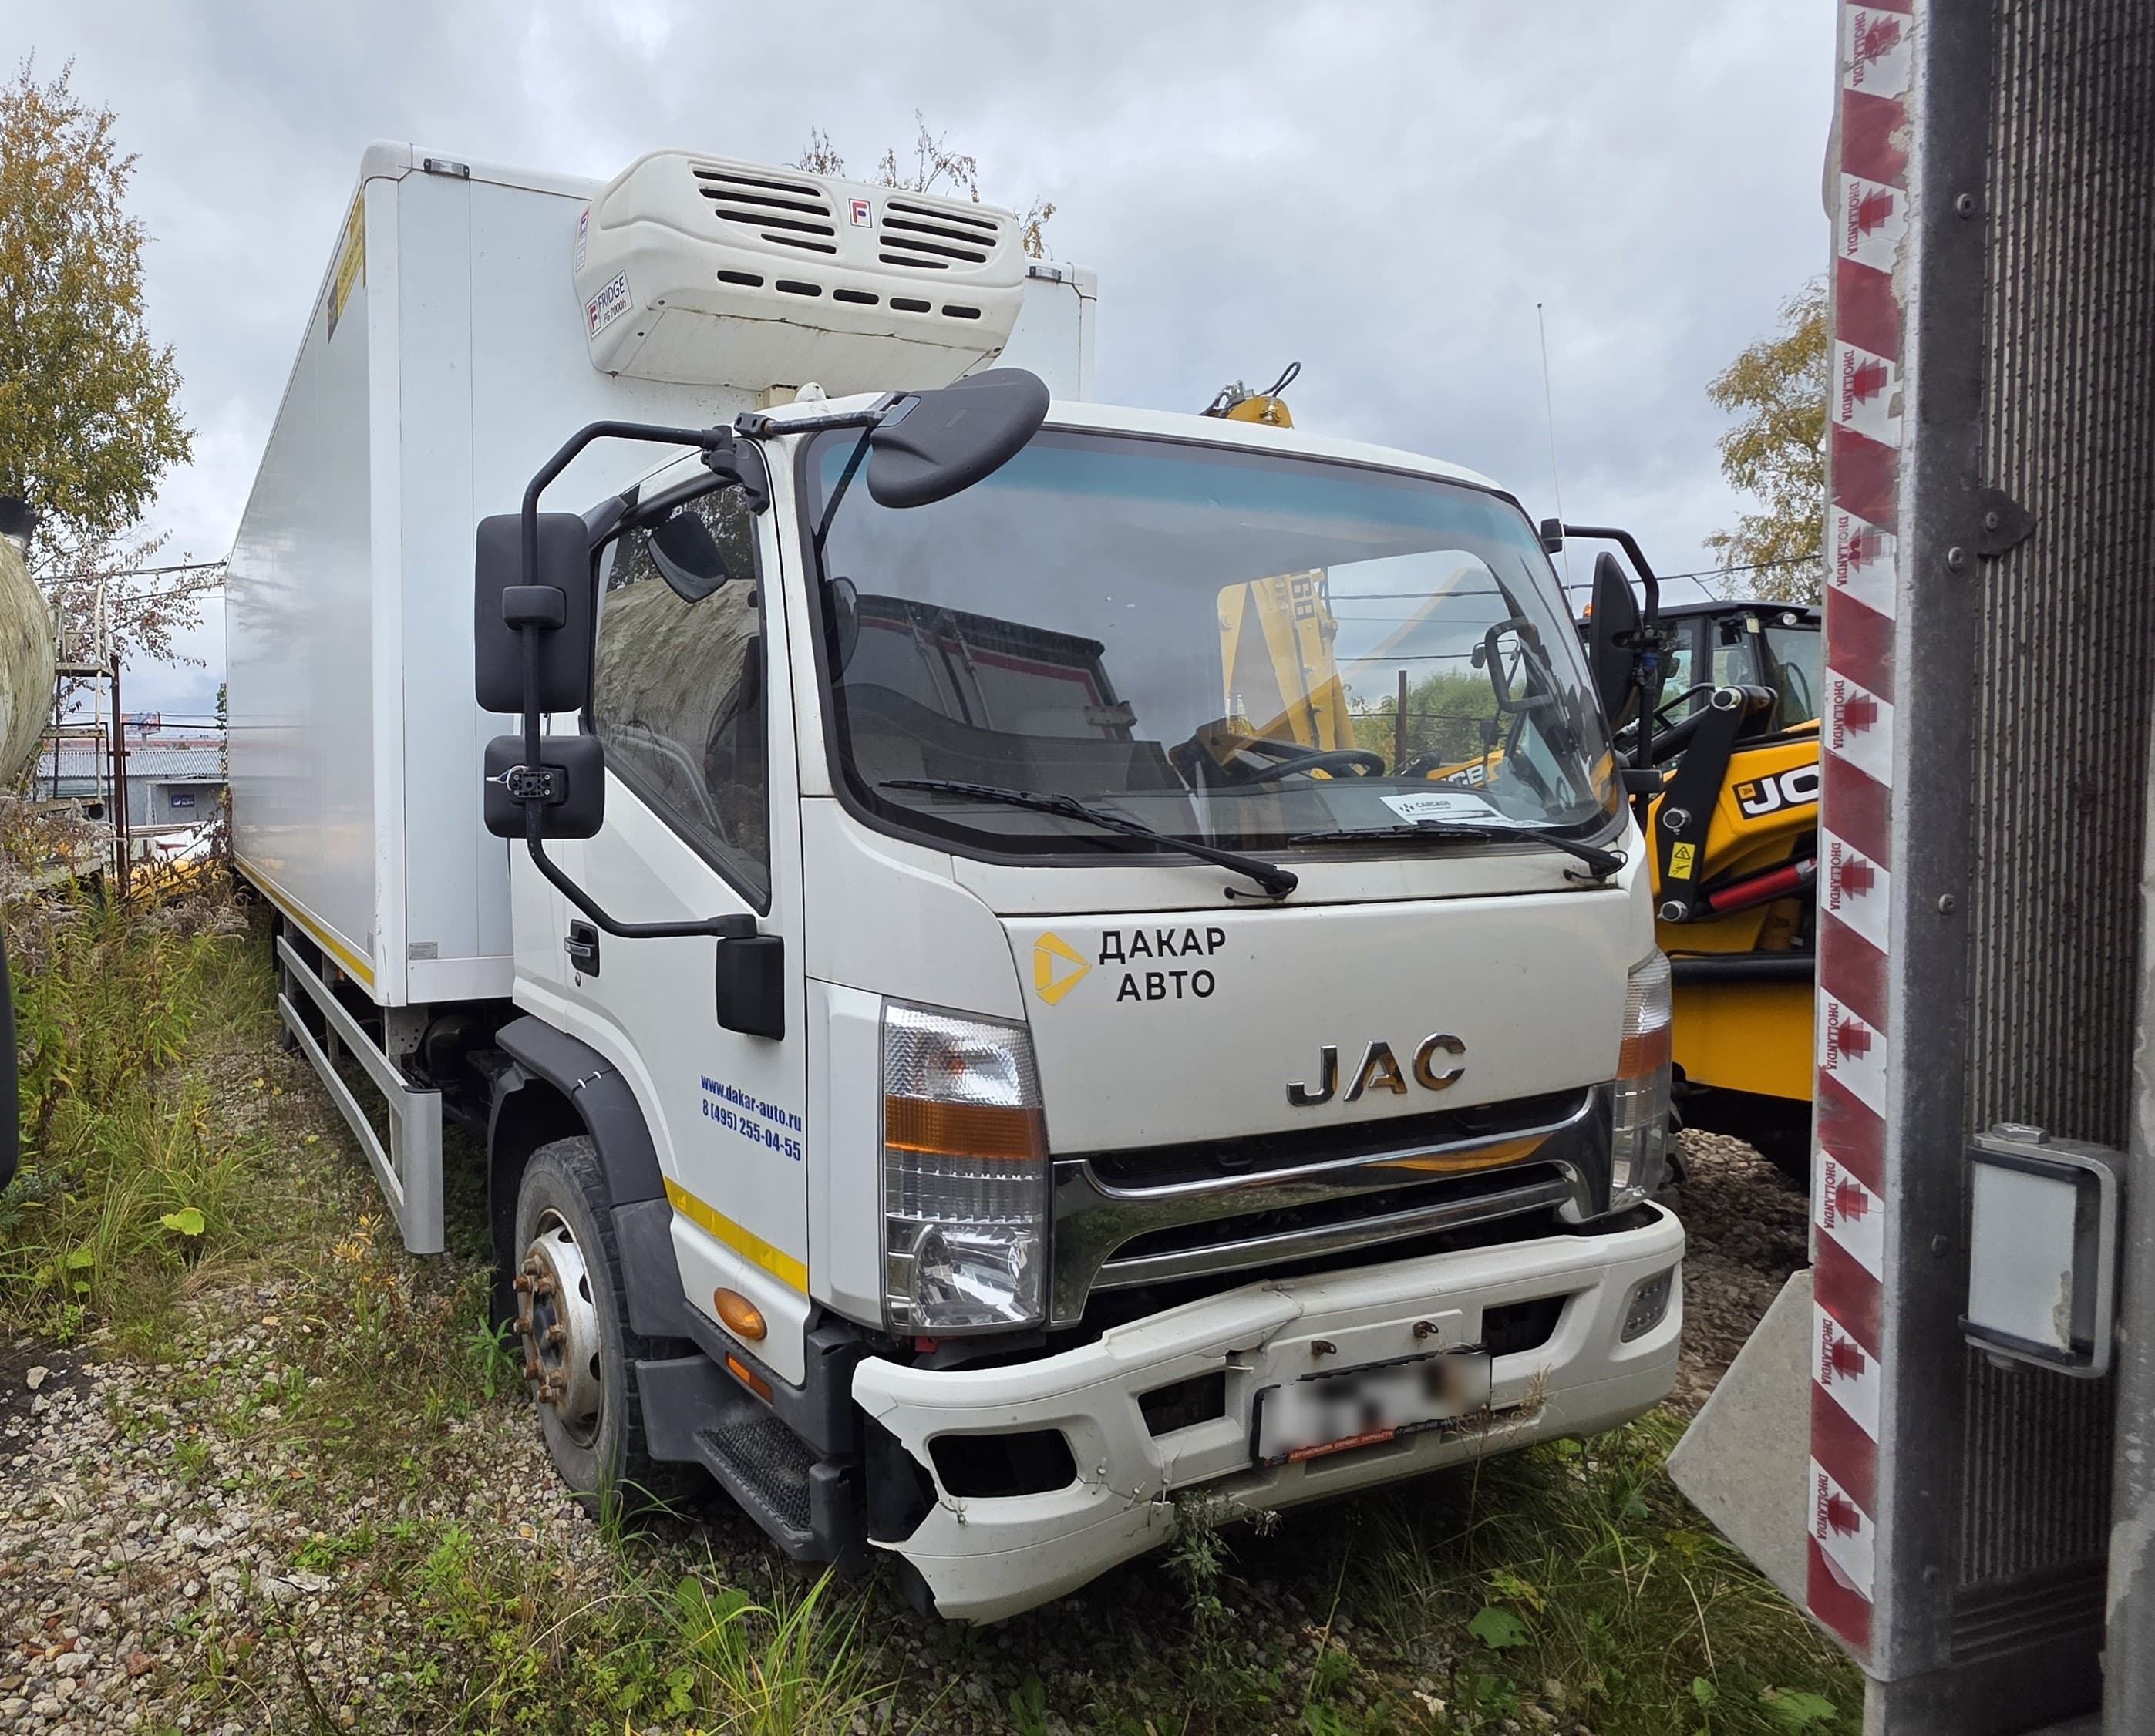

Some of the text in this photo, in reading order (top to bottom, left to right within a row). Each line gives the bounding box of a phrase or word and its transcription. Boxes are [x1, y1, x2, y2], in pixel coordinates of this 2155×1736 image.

[1847, 181, 1860, 256] DHOLLANDIA
[598, 275, 625, 311] FRIDGE
[1842, 349, 1855, 422] DHOLLANDIA
[1833, 679, 1845, 750] DHOLLANDIA
[1743, 764, 1819, 814] JC
[1830, 842, 1842, 911] DHOLLANDIA
[1099, 927, 1227, 965] ДАКАР
[1116, 969, 1216, 1002] АВТО
[1286, 1031, 1466, 1107] JAC
[1826, 1002, 1839, 1071] DHOLLANDIA
[700, 1074, 803, 1132] www.dakar-auto.ru
[702, 1098, 801, 1162] 8 (495) 255-04-55
[1823, 1161, 1836, 1229] DHOLLANDIA
[1821, 1318, 1833, 1386] DHOLLANDIA
[1817, 1473, 1829, 1541] DHOLLANDIA
